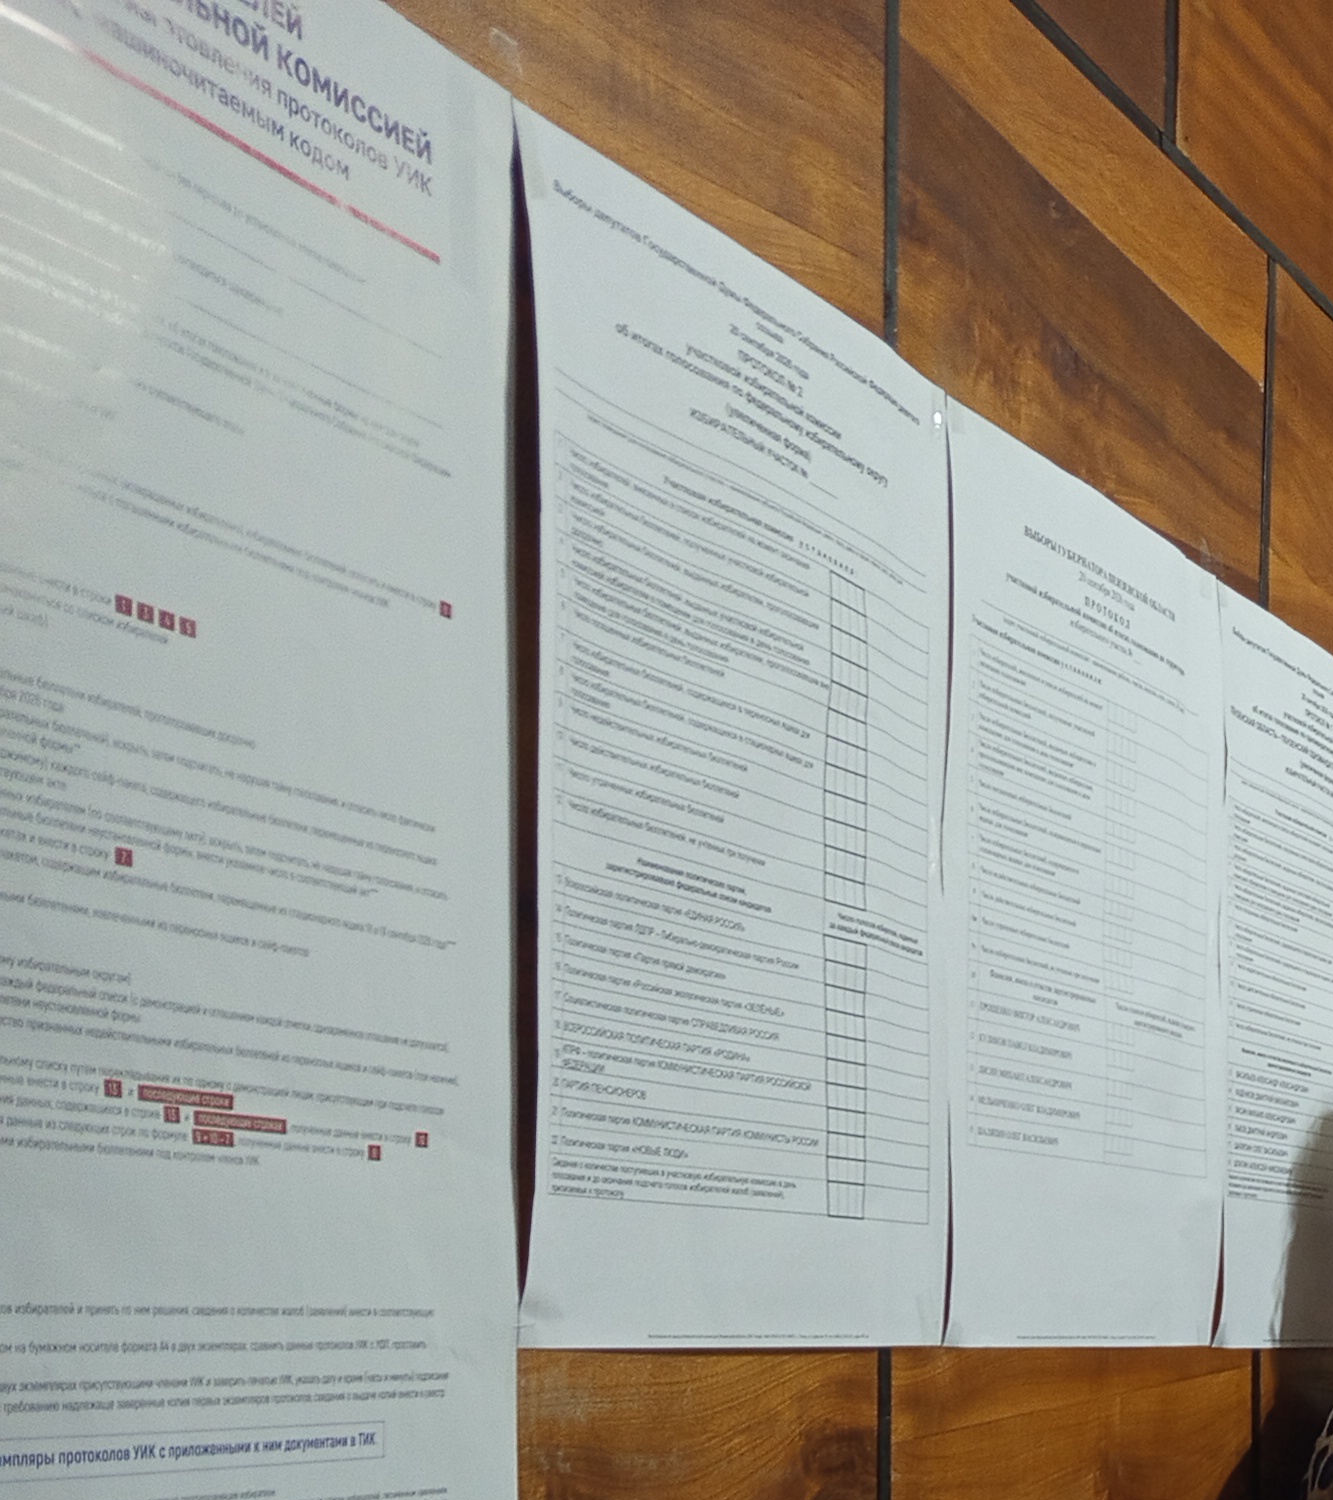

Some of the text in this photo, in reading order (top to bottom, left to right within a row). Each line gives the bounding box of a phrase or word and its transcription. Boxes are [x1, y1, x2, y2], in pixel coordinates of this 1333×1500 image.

[277, 43, 433, 165] КОМИССИЕЙ
[277, 86, 388, 171] протоколов
[394, 154, 433, 197] УИК
[289, 130, 349, 181] кодом
[58, 1448, 130, 1467] протоколов
[133, 1444, 156, 1459] УИК
[168, 1441, 251, 1460] приложенными
[262, 1440, 281, 1451] ним
[283, 1436, 348, 1452] документами
[358, 1432, 376, 1446] ТИК
